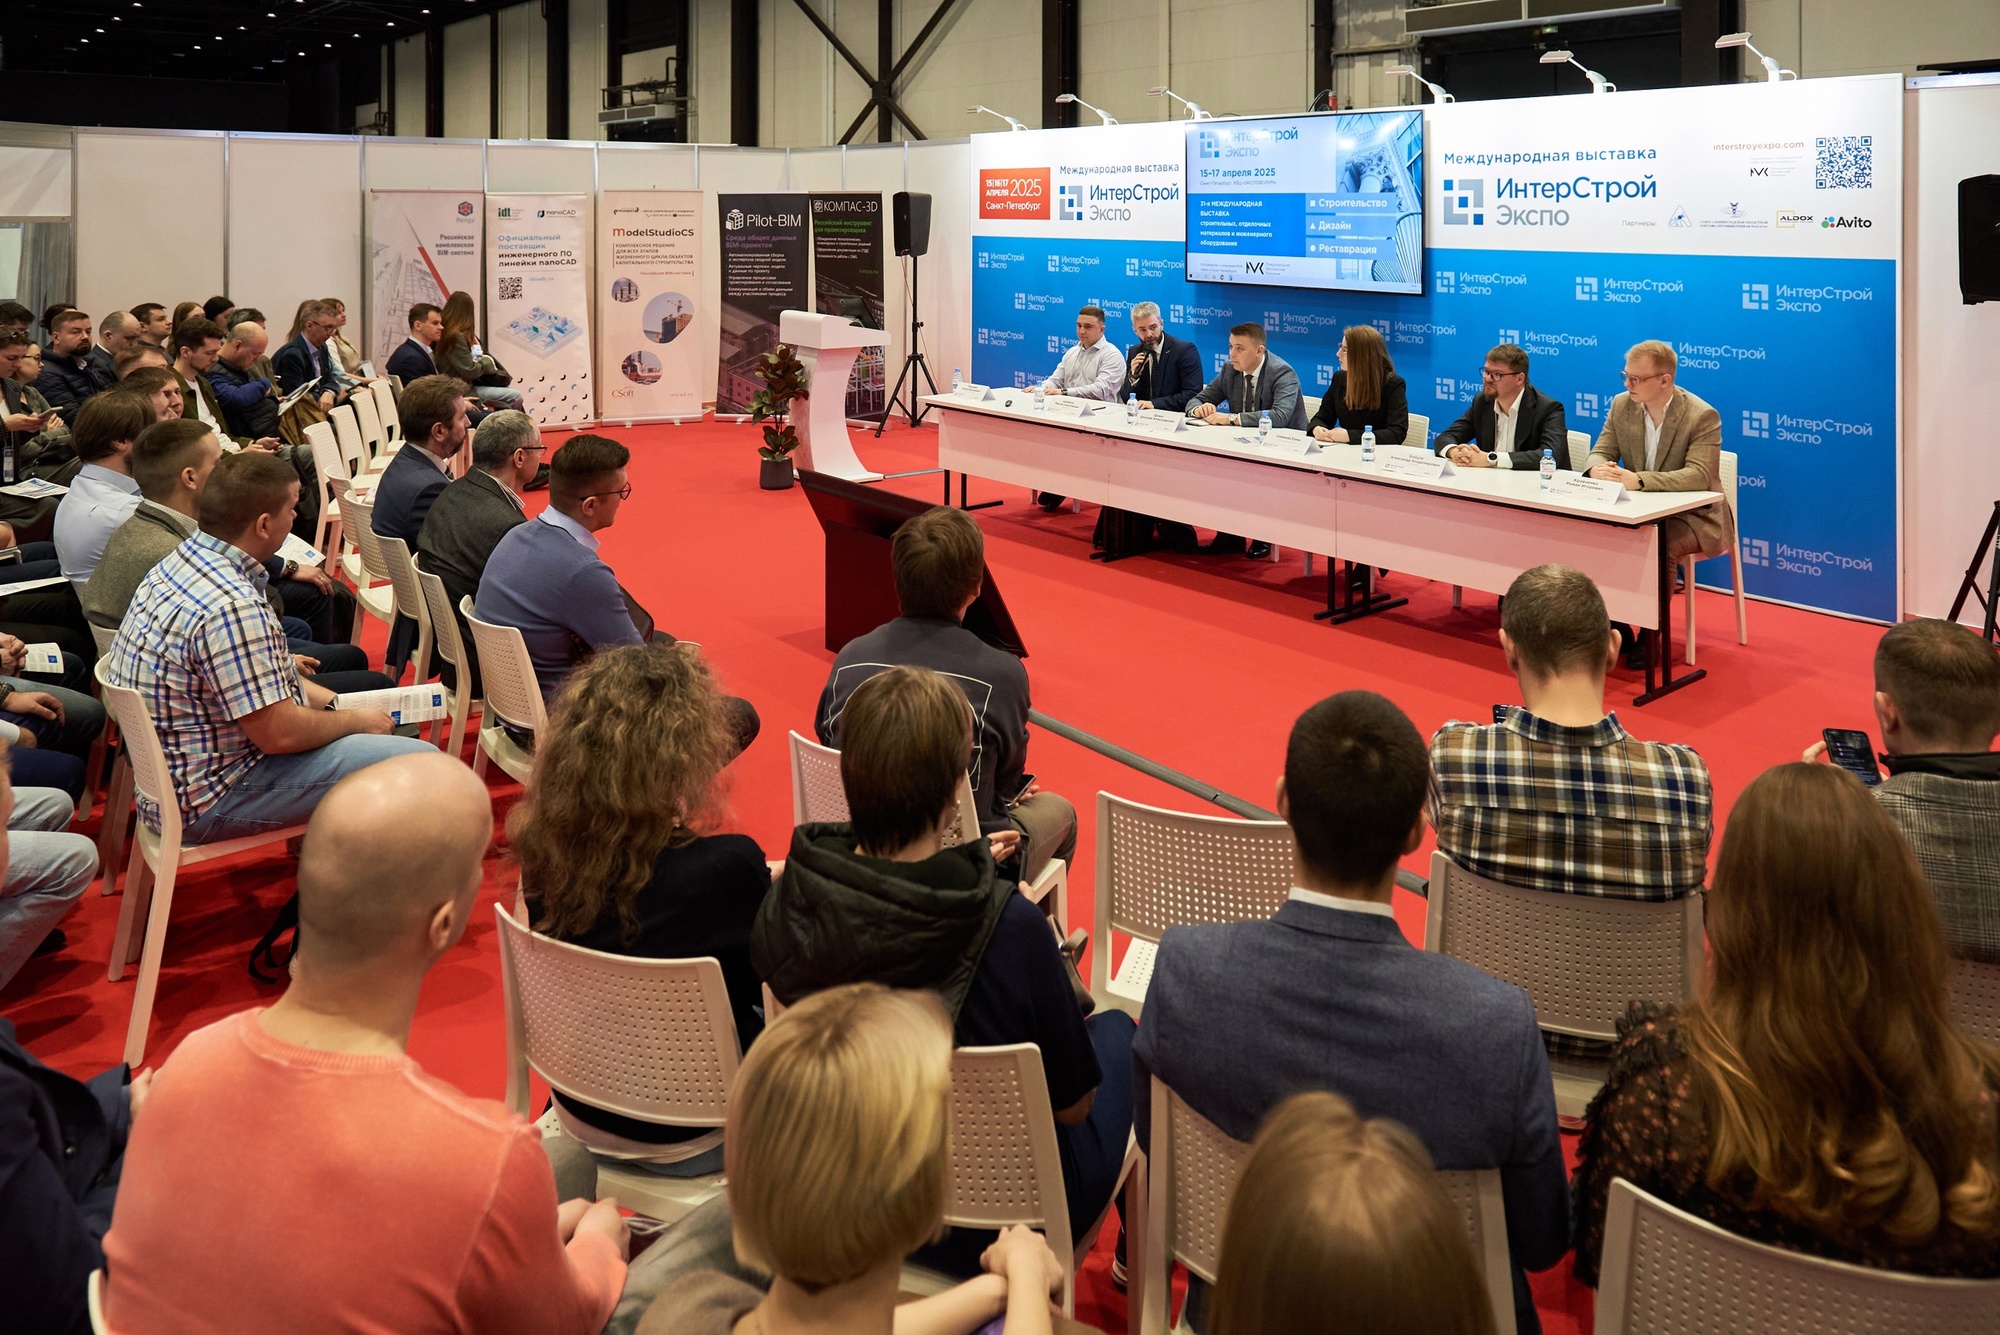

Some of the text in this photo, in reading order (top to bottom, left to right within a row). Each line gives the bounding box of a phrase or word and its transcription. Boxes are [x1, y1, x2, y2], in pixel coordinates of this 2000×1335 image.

[1225, 145, 1259, 158] Экспо
[1713, 142, 1804, 152] interstroyexpo.com
[1444, 149, 1656, 166] Международная выставка
[1060, 164, 1180, 176] Международная выставка
[1200, 168, 1276, 179] 15-17 апреля 2025
[986, 188, 1008, 197] АПРЕЛЯ
[1010, 178, 1042, 197] 2025
[1090, 182, 1179, 204] ИнтерСтрой
[1496, 174, 1656, 202] ИнтерСтрой
[824, 200, 878, 212] КОМПАС-3D
[986, 200, 1042, 212] Санкт-Петербург
[1211, 200, 1262, 208] МЕЖДУНАРОДНАЯ
[1318, 198, 1388, 208] Строительство
[498, 208, 511, 217] idt
[1090, 204, 1132, 221] Экспо
[1496, 204, 1570, 226] Экспо
[747, 214, 801, 227] Pilot-BIM
[1318, 220, 1352, 232] Дизайн
[1836, 216, 1872, 228] Avito
[498, 234, 560, 242] Официальный
[748, 234, 770, 242] общих
[1319, 243, 1376, 255] Реставрация
[990, 252, 1024, 262] ИнтерСтрой
[1061, 255, 1099, 265] ИнтерСтрой
[990, 261, 1007, 269] Экспо
[1061, 263, 1080, 273] Экспо
[1142, 259, 1184, 270] ИнтерСтрой
[1141, 268, 1162, 277] Экспо
[1460, 272, 1526, 287] ИнтерСтрой
[1604, 277, 1684, 293] ИнтерСтрой
[1460, 284, 1491, 295] Экспо
[1776, 284, 1872, 302] ИнтерСтрой
[1028, 294, 1064, 304] ИнтерСтрой
[1604, 290, 1642, 304] Экспо
[1028, 303, 1045, 311] Экспо
[1187, 305, 1232, 318] ИнтерСтрой
[1776, 299, 1822, 313] Экспо
[1186, 316, 1209, 326] Экспо
[1283, 313, 1336, 327] ИнтерСтрой
[990, 328, 1024, 340] ИнтерСтрой
[1283, 323, 1308, 334] Экспо
[1394, 321, 1456, 336] ИнтерСтрой
[990, 338, 1007, 347] Экспо
[1394, 333, 1424, 344] Экспо
[1525, 330, 1598, 347] ИнтерСтрой
[1525, 343, 1559, 356] Экспо
[1680, 342, 1766, 360] ИнтерСтрой
[1679, 355, 1720, 370] Экспо
[612, 386, 634, 398] CSoft
[1776, 414, 1873, 436] ИнтерСтрой
[1776, 429, 1822, 444] Экспо
[1776, 543, 1873, 571] ИнтерСтрой
[1776, 558, 1822, 576] Экспо
